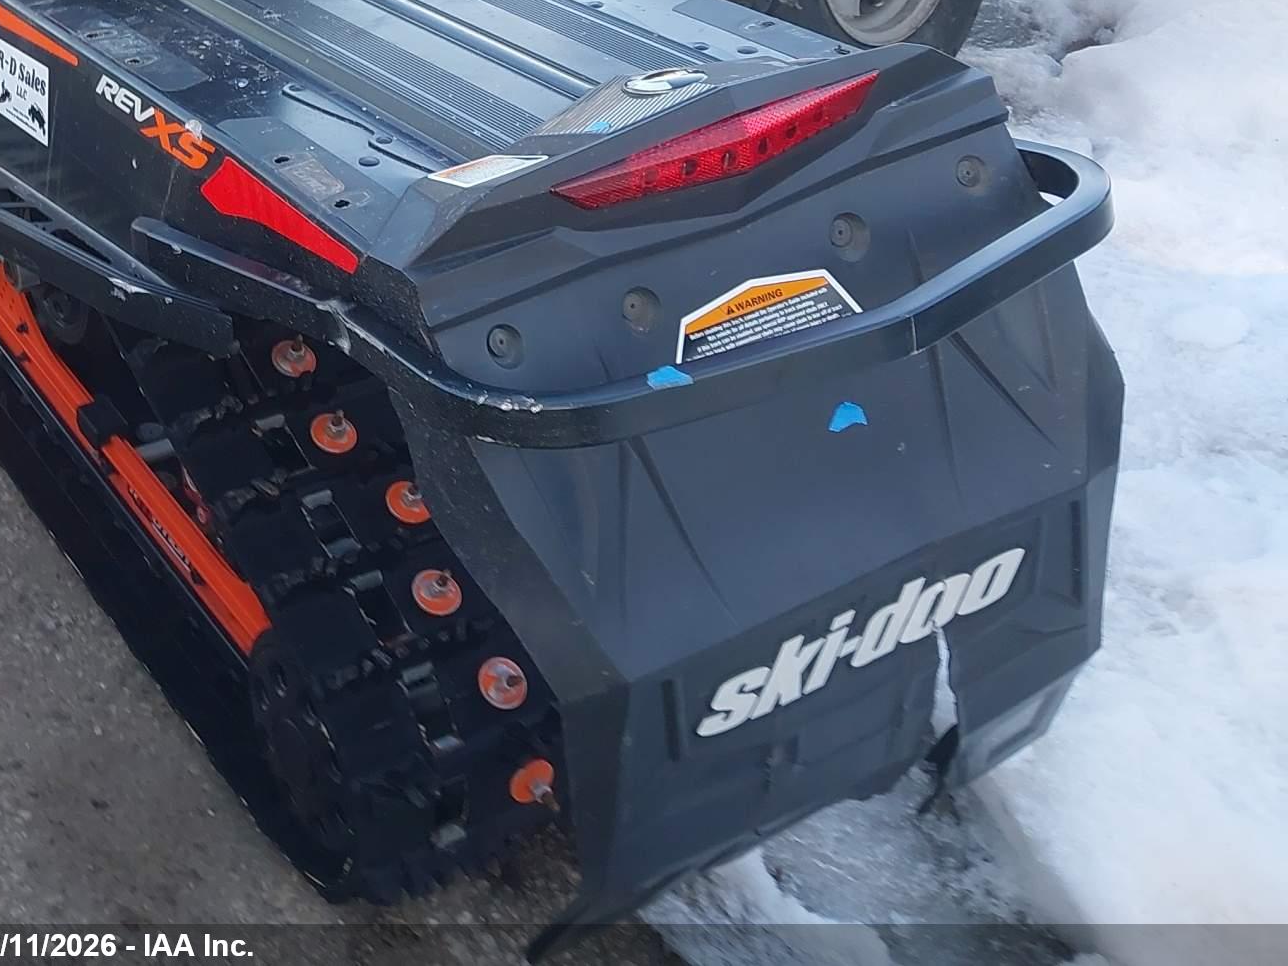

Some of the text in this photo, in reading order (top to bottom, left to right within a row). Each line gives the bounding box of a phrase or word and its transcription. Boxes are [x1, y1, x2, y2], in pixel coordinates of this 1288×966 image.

[16, 83, 28, 101] LLC
[18, 63, 47, 96] Sales
[735, 288, 784, 312] WARNING
[696, 548, 1026, 737] ski-doo
